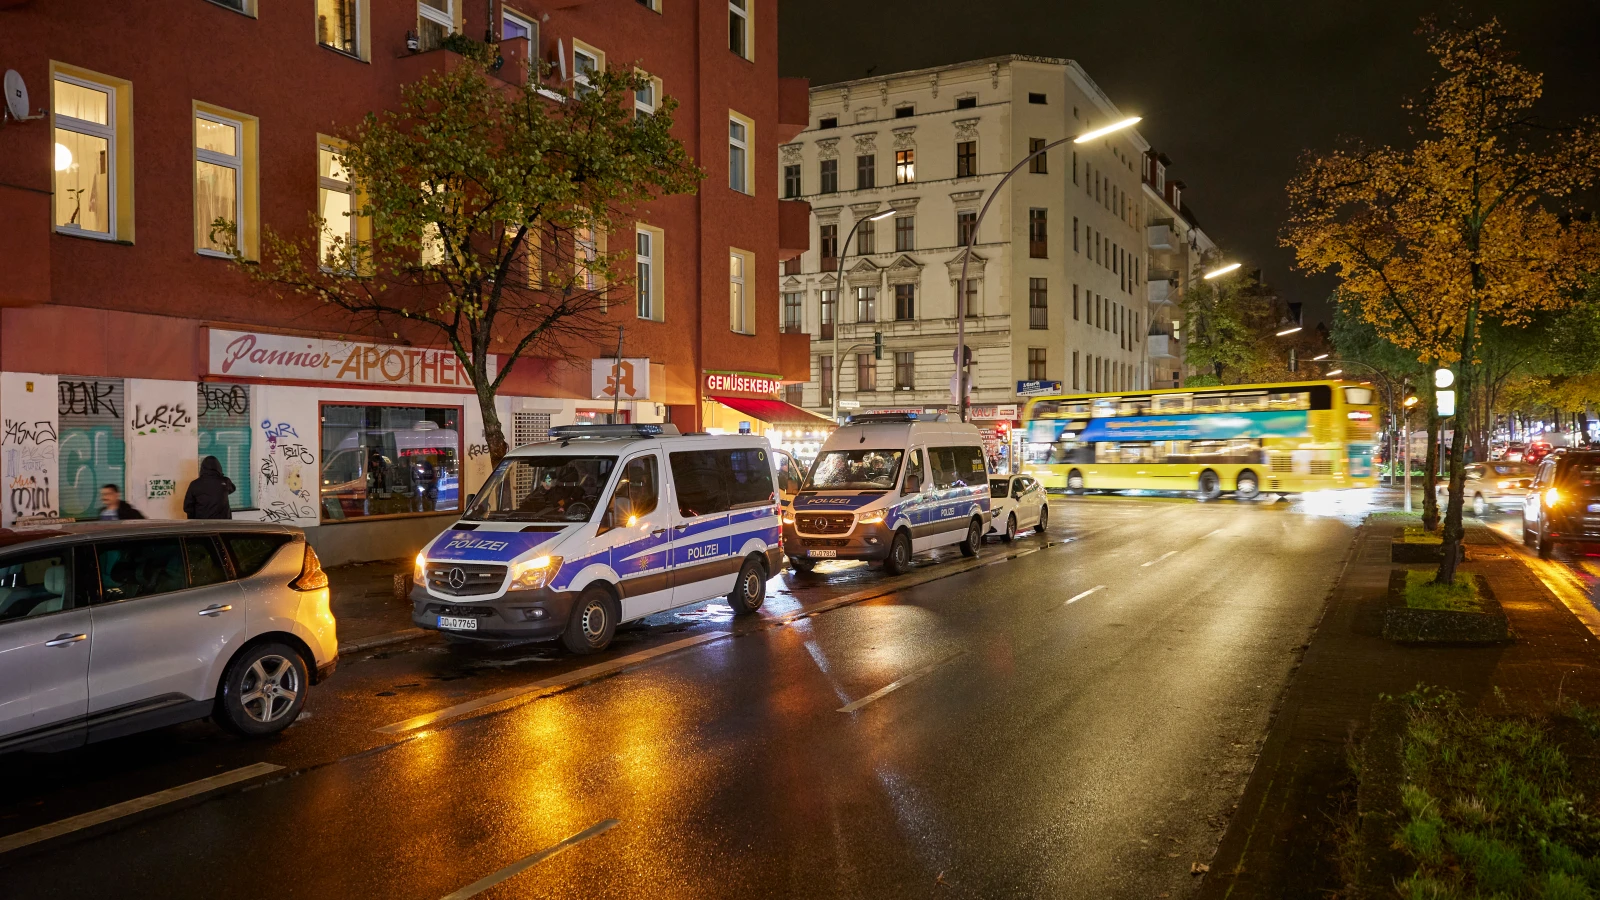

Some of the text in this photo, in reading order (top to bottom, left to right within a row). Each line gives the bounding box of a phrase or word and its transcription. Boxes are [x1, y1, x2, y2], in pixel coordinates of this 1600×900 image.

[222, 334, 475, 386] Pannier-APOTHEK
[708, 373, 780, 394] GEMÜSEKEBAP
[444, 540, 508, 551] POLIZEI
[688, 543, 719, 560] POLIZEI
[458, 619, 476, 629] 7765
